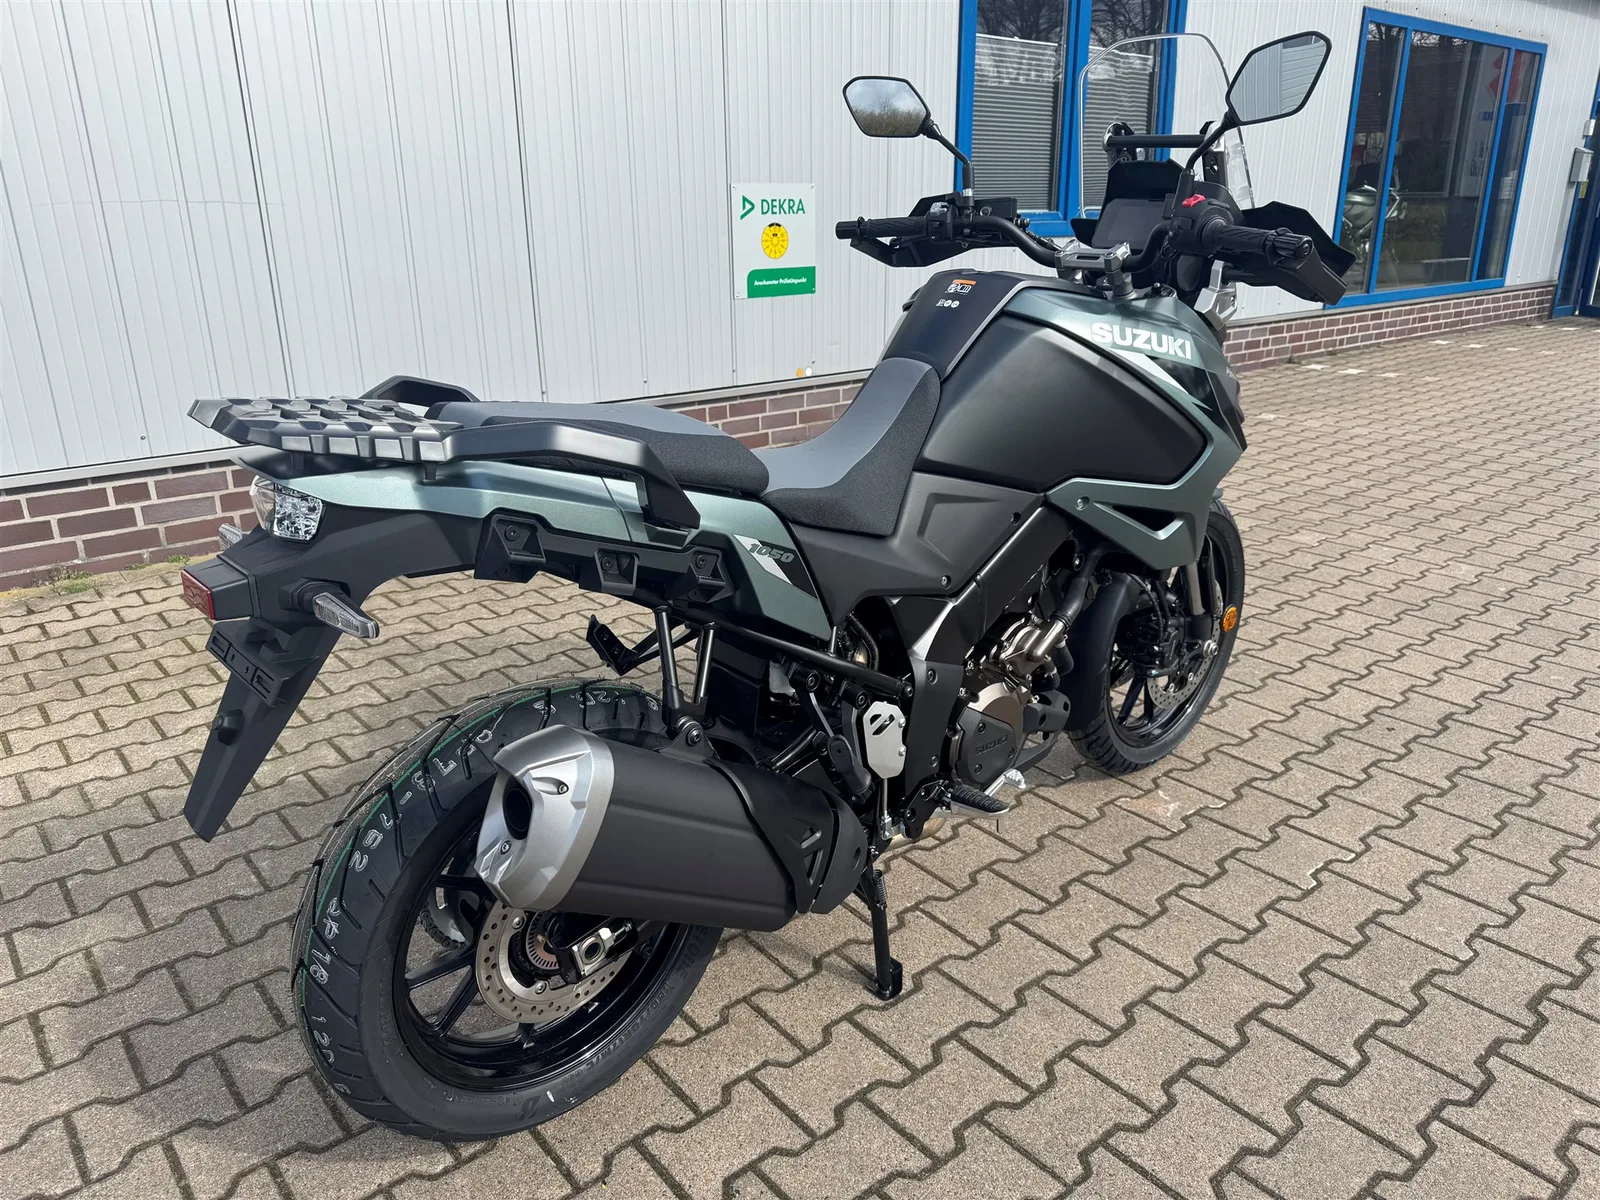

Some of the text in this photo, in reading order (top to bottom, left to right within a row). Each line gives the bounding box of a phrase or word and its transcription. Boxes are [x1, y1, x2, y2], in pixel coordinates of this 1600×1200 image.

[760, 198, 806, 215] DEKRA
[1090, 322, 1192, 360] SUZUKI
[748, 543, 795, 563] 1050
